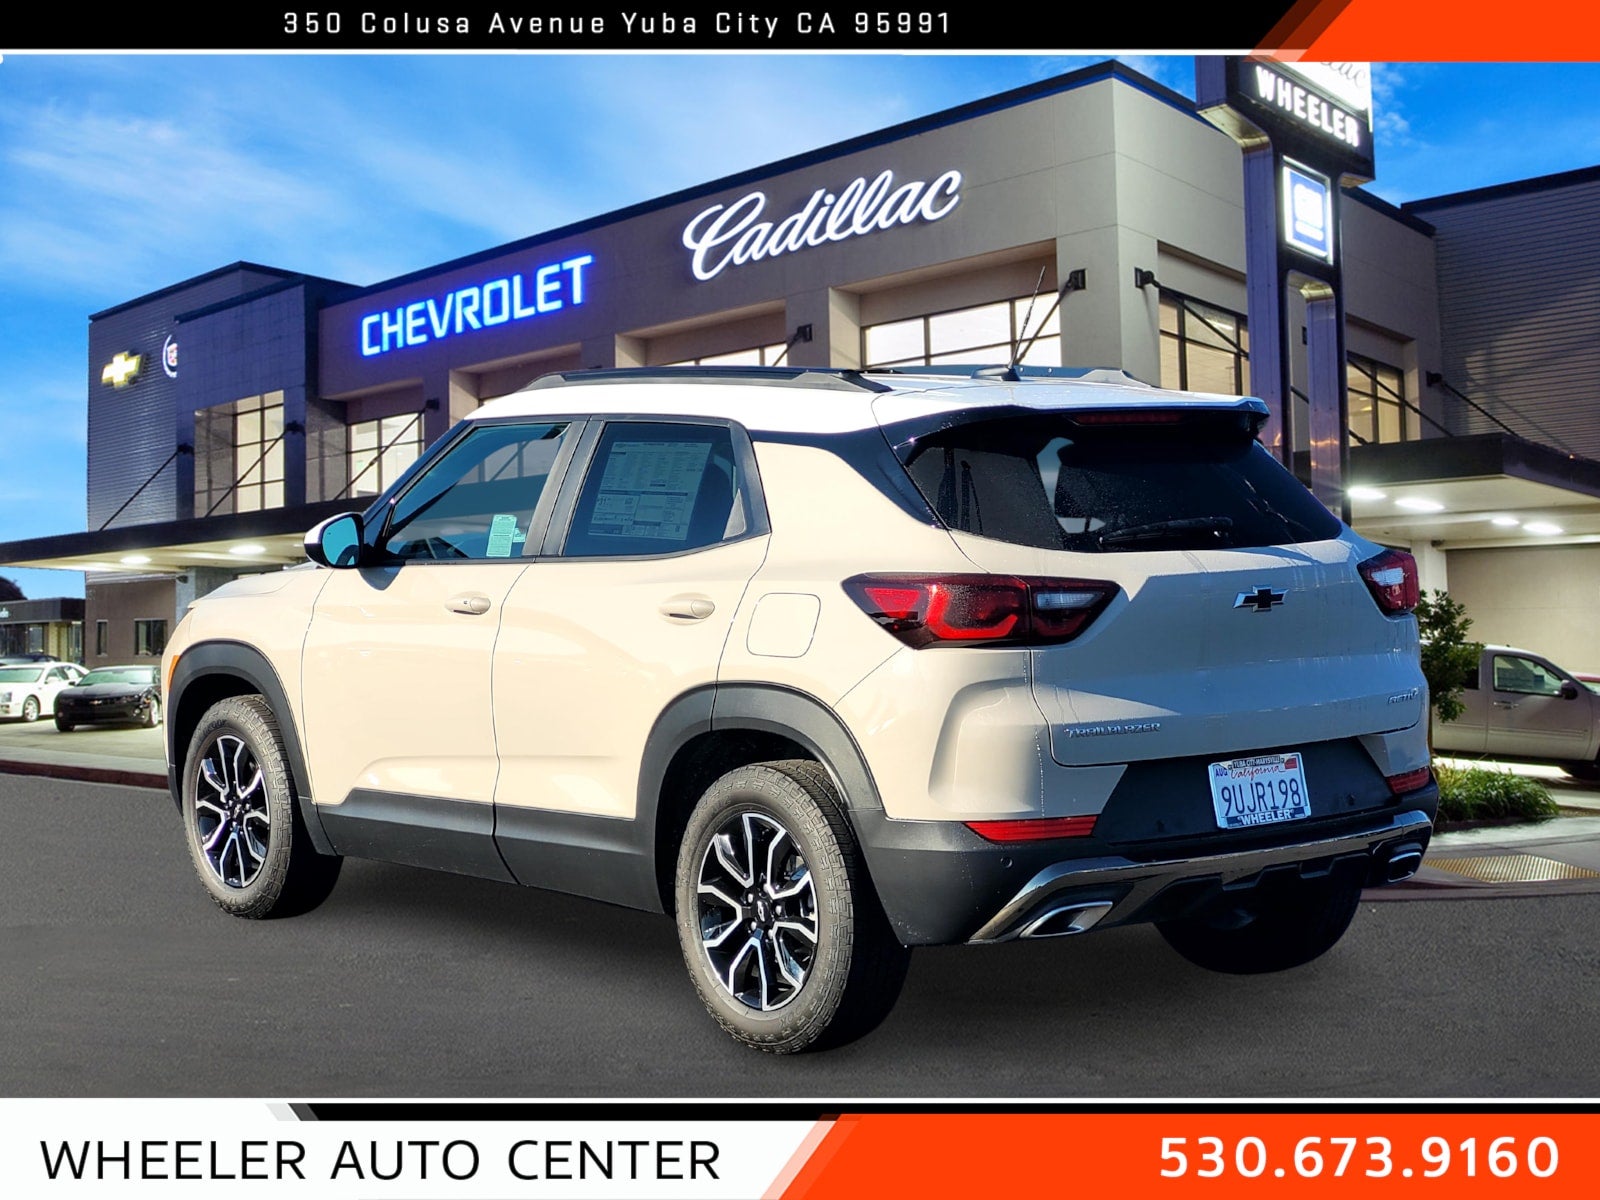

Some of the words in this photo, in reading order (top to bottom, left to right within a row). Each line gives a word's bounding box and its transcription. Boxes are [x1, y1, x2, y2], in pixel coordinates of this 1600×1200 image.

[1255, 65, 1360, 148] WHEELER
[682, 169, 963, 281] Cadillac
[361, 254, 593, 357] CHEVROLET
[1064, 723, 1161, 738] TRAILBLAZER
[1215, 768, 1228, 777] AUG
[1230, 765, 1280, 781] California
[1221, 778, 1301, 816] 9UJR198
[1240, 809, 1292, 825] WHEELER
